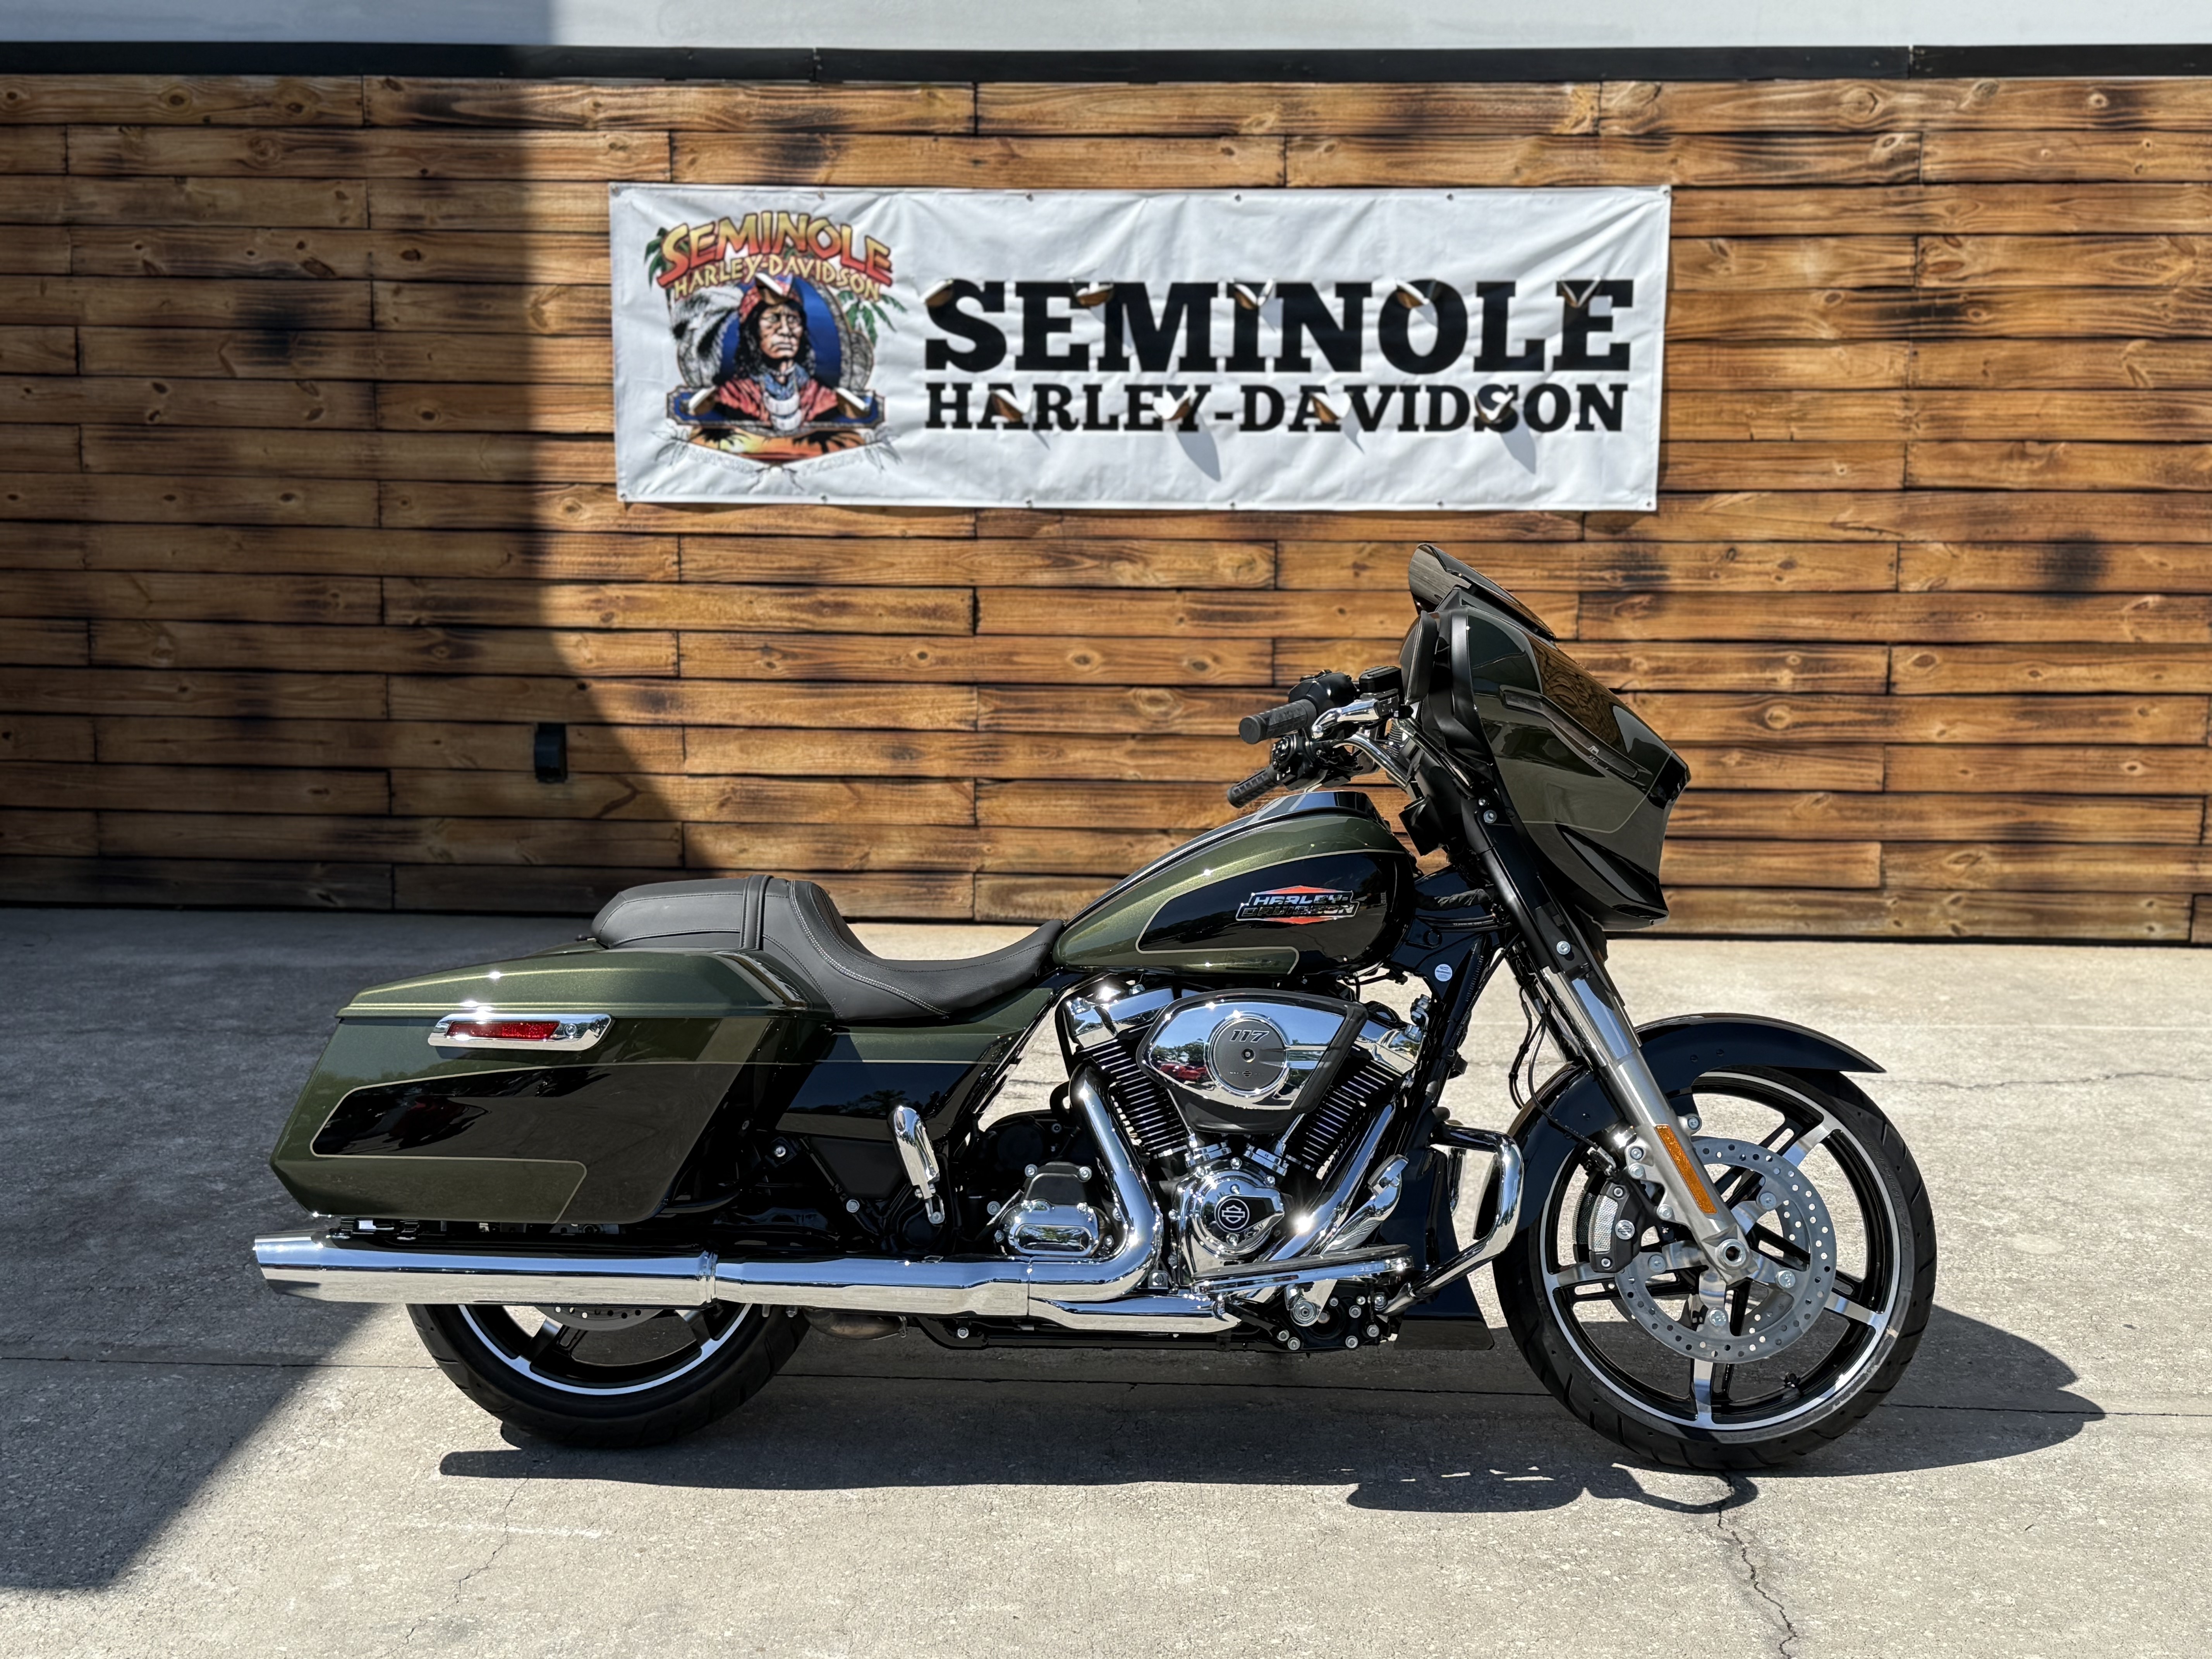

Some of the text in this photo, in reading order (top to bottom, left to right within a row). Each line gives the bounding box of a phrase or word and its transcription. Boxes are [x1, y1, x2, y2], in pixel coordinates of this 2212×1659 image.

[657, 211, 892, 287] SEMINOLE
[674, 254, 881, 301] HARLEY-DAVIDSON
[926, 279, 1633, 374] SEMINOLE
[1230, 1029, 1269, 1042] 117
